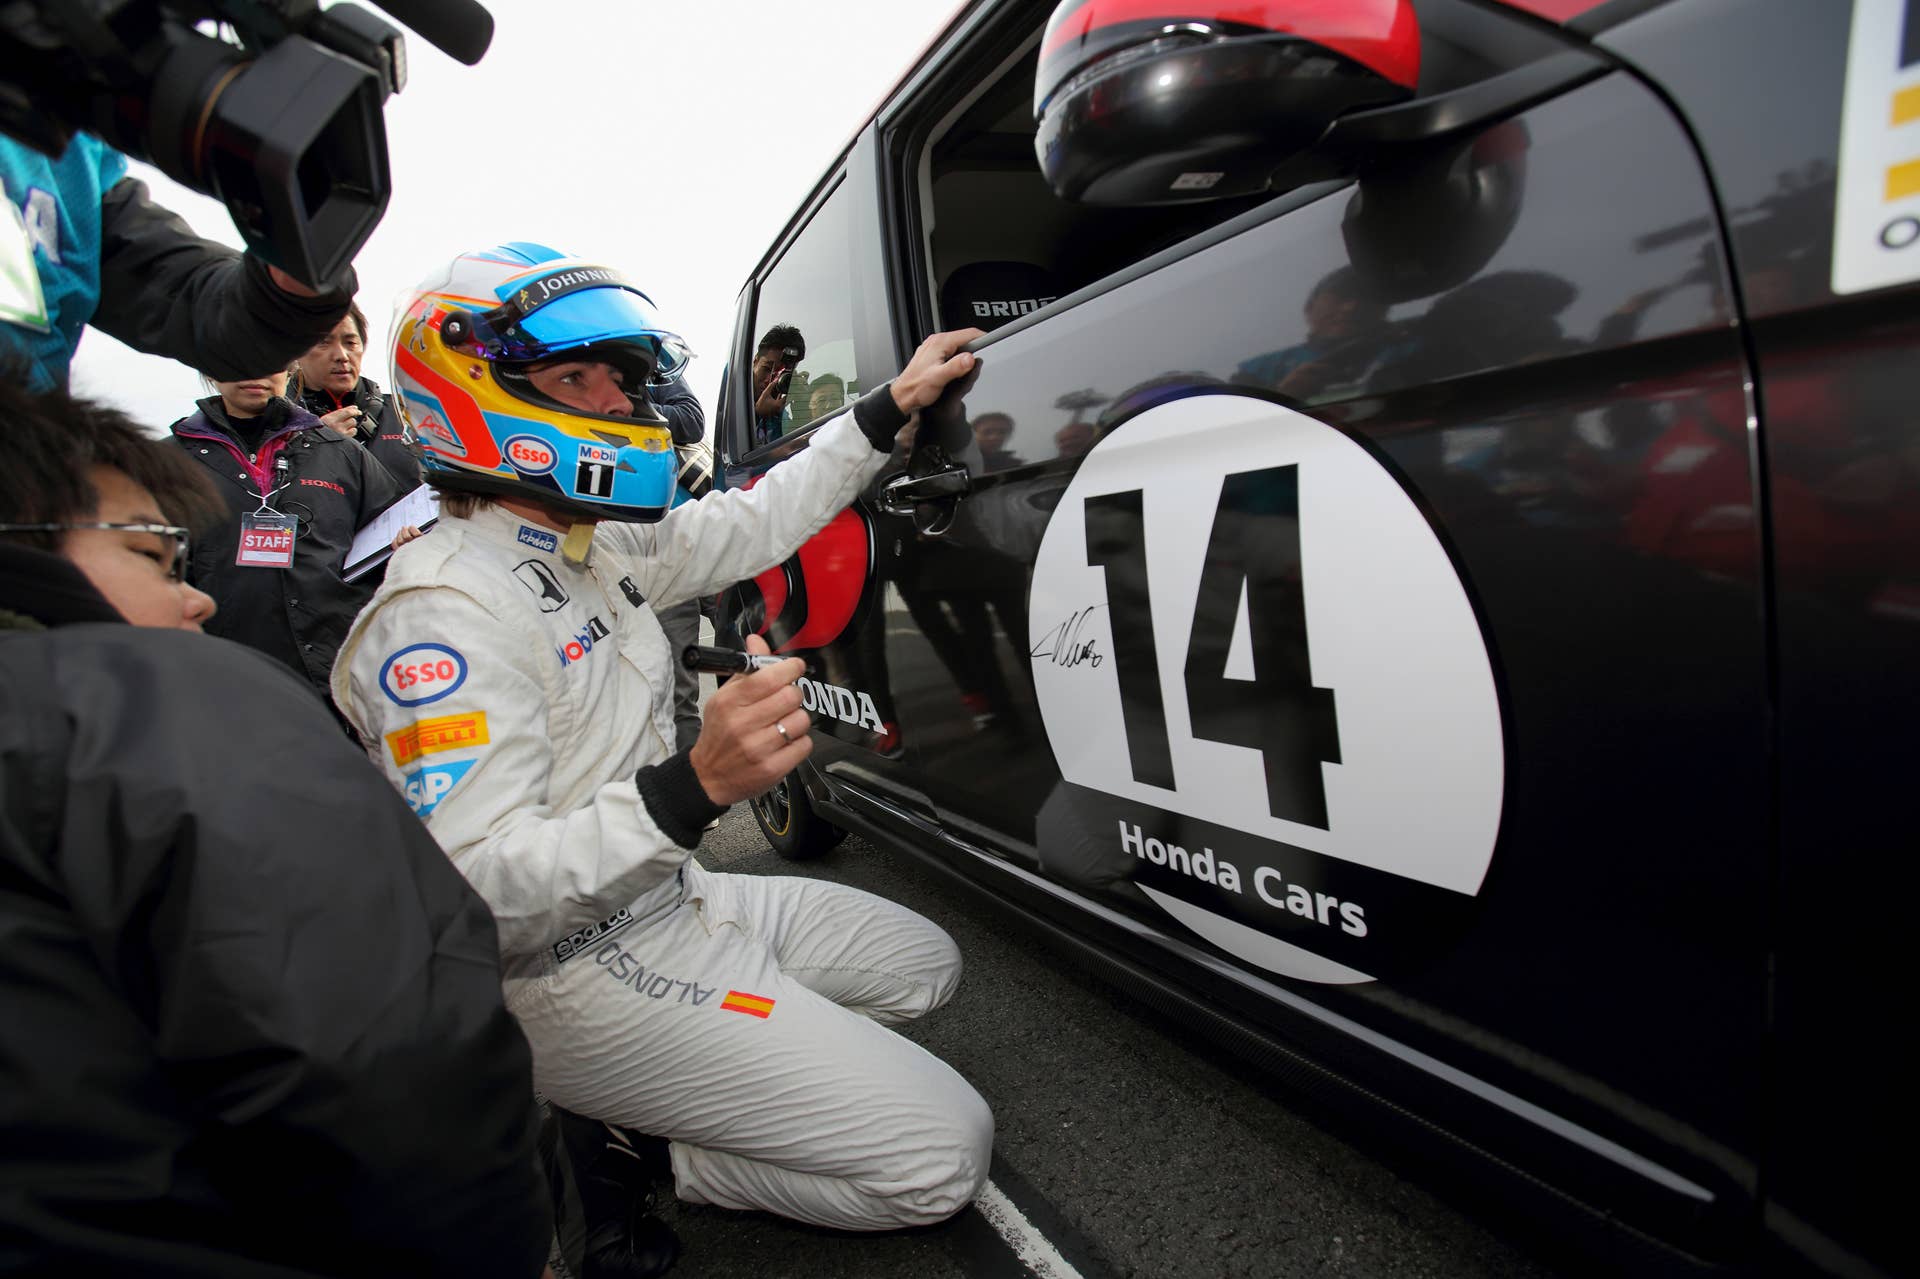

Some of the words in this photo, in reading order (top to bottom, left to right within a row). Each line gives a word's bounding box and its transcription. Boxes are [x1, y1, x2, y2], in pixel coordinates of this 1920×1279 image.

[580, 446, 616, 462] Mobil
[588, 464, 602, 495] 1
[245, 535, 291, 548] STAFF
[519, 533, 554, 550] KPMG
[1085, 463, 1342, 832] 14
[791, 677, 888, 735] ONDA
[1119, 820, 1242, 894] Honda
[1254, 866, 1368, 938] Cars
[557, 907, 630, 954] sparco
[596, 941, 718, 1007] ALONSO
